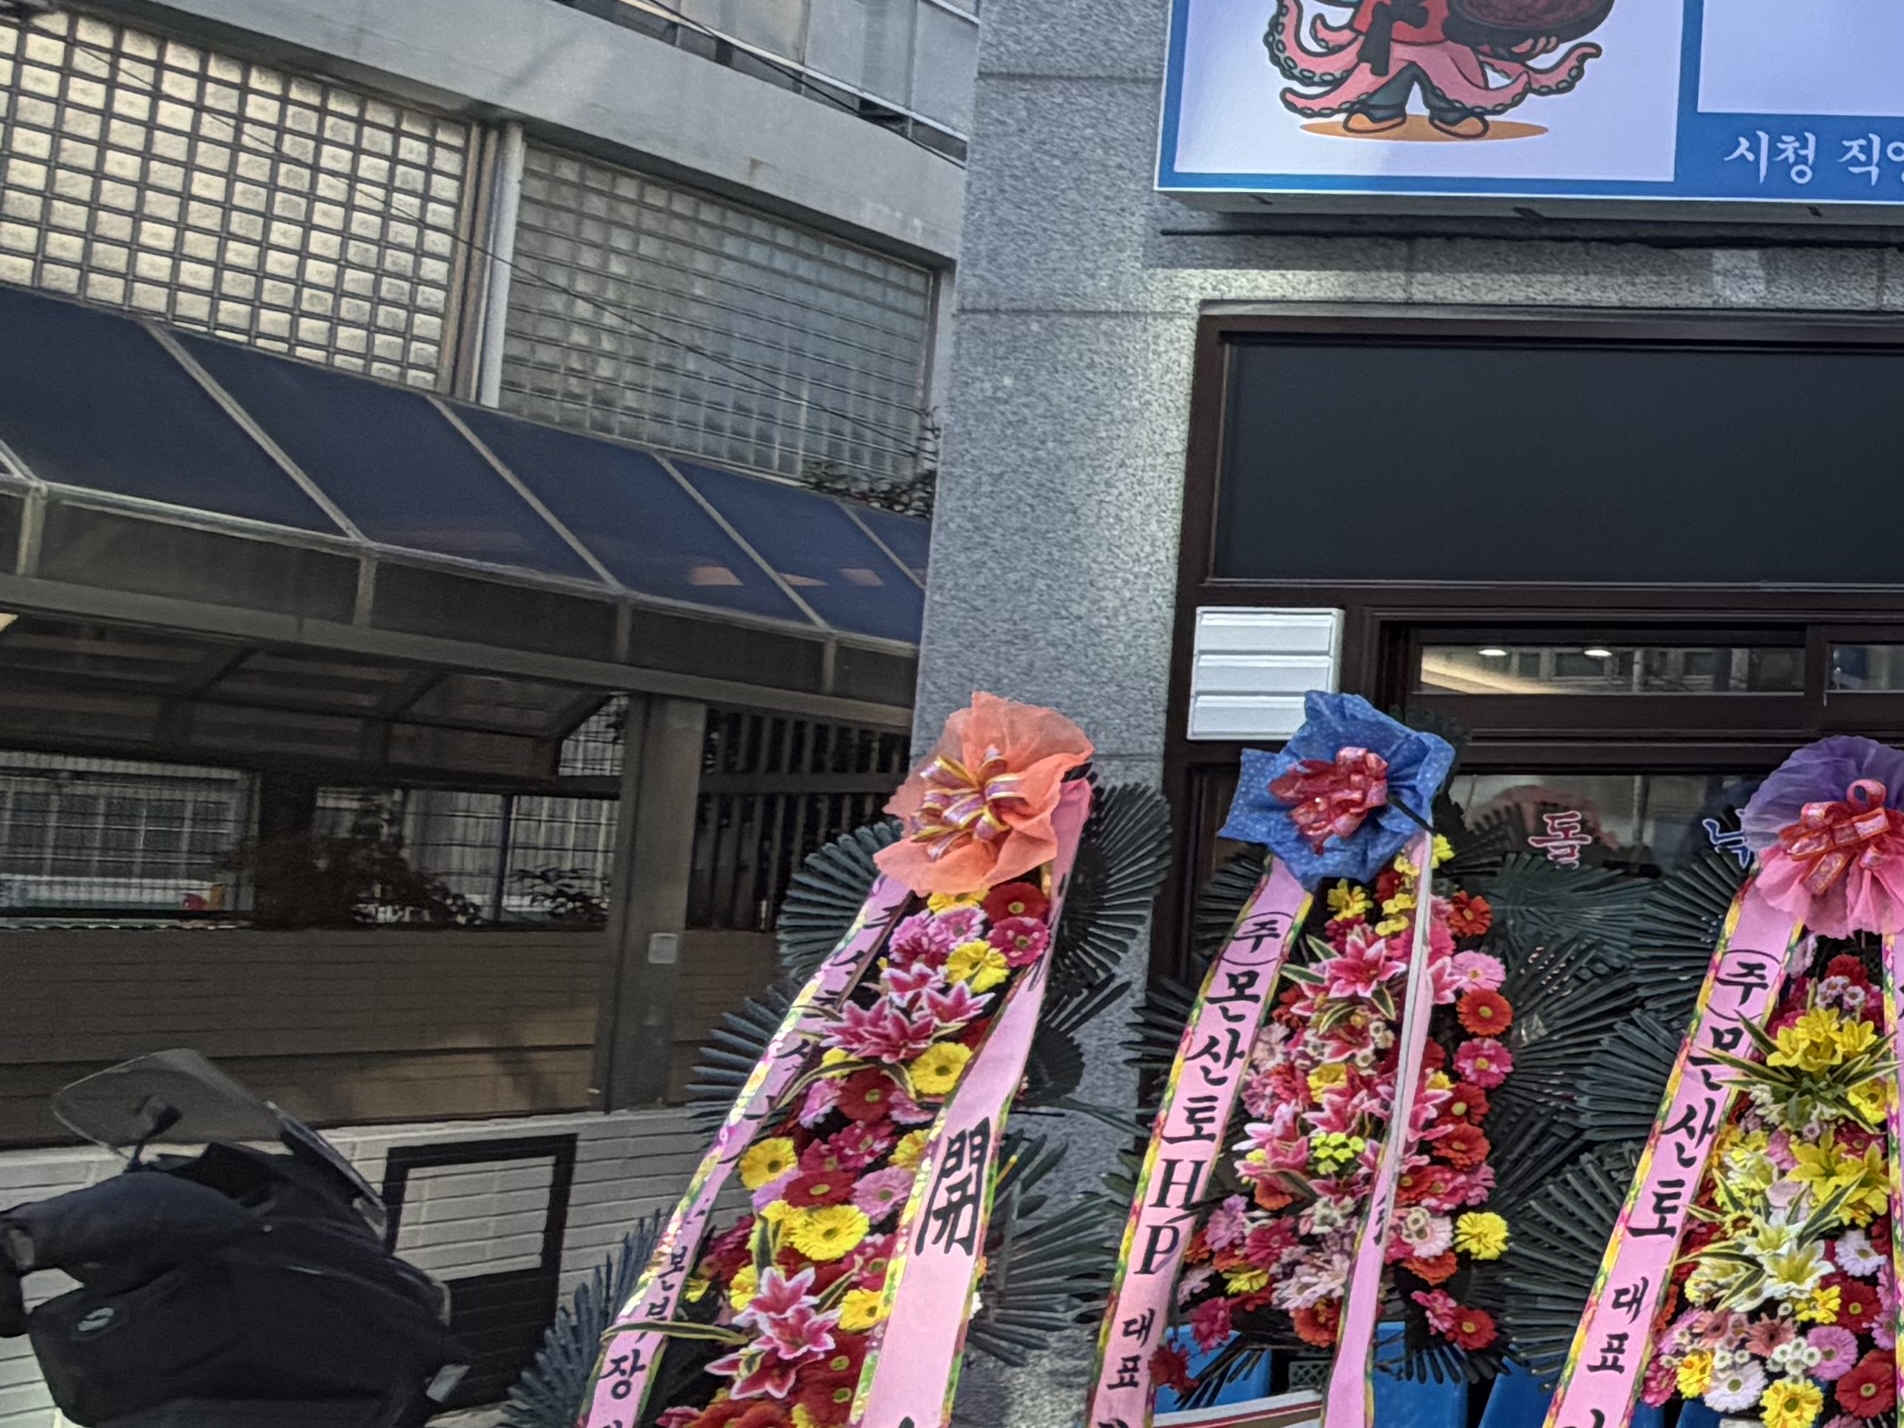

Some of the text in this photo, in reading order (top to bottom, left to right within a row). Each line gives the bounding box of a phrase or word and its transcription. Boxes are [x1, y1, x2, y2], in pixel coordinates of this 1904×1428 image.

[1724, 129, 1817, 187] 시청
[1105, 1307, 1158, 1392] 대표
[1585, 1276, 1651, 1376] 대표
